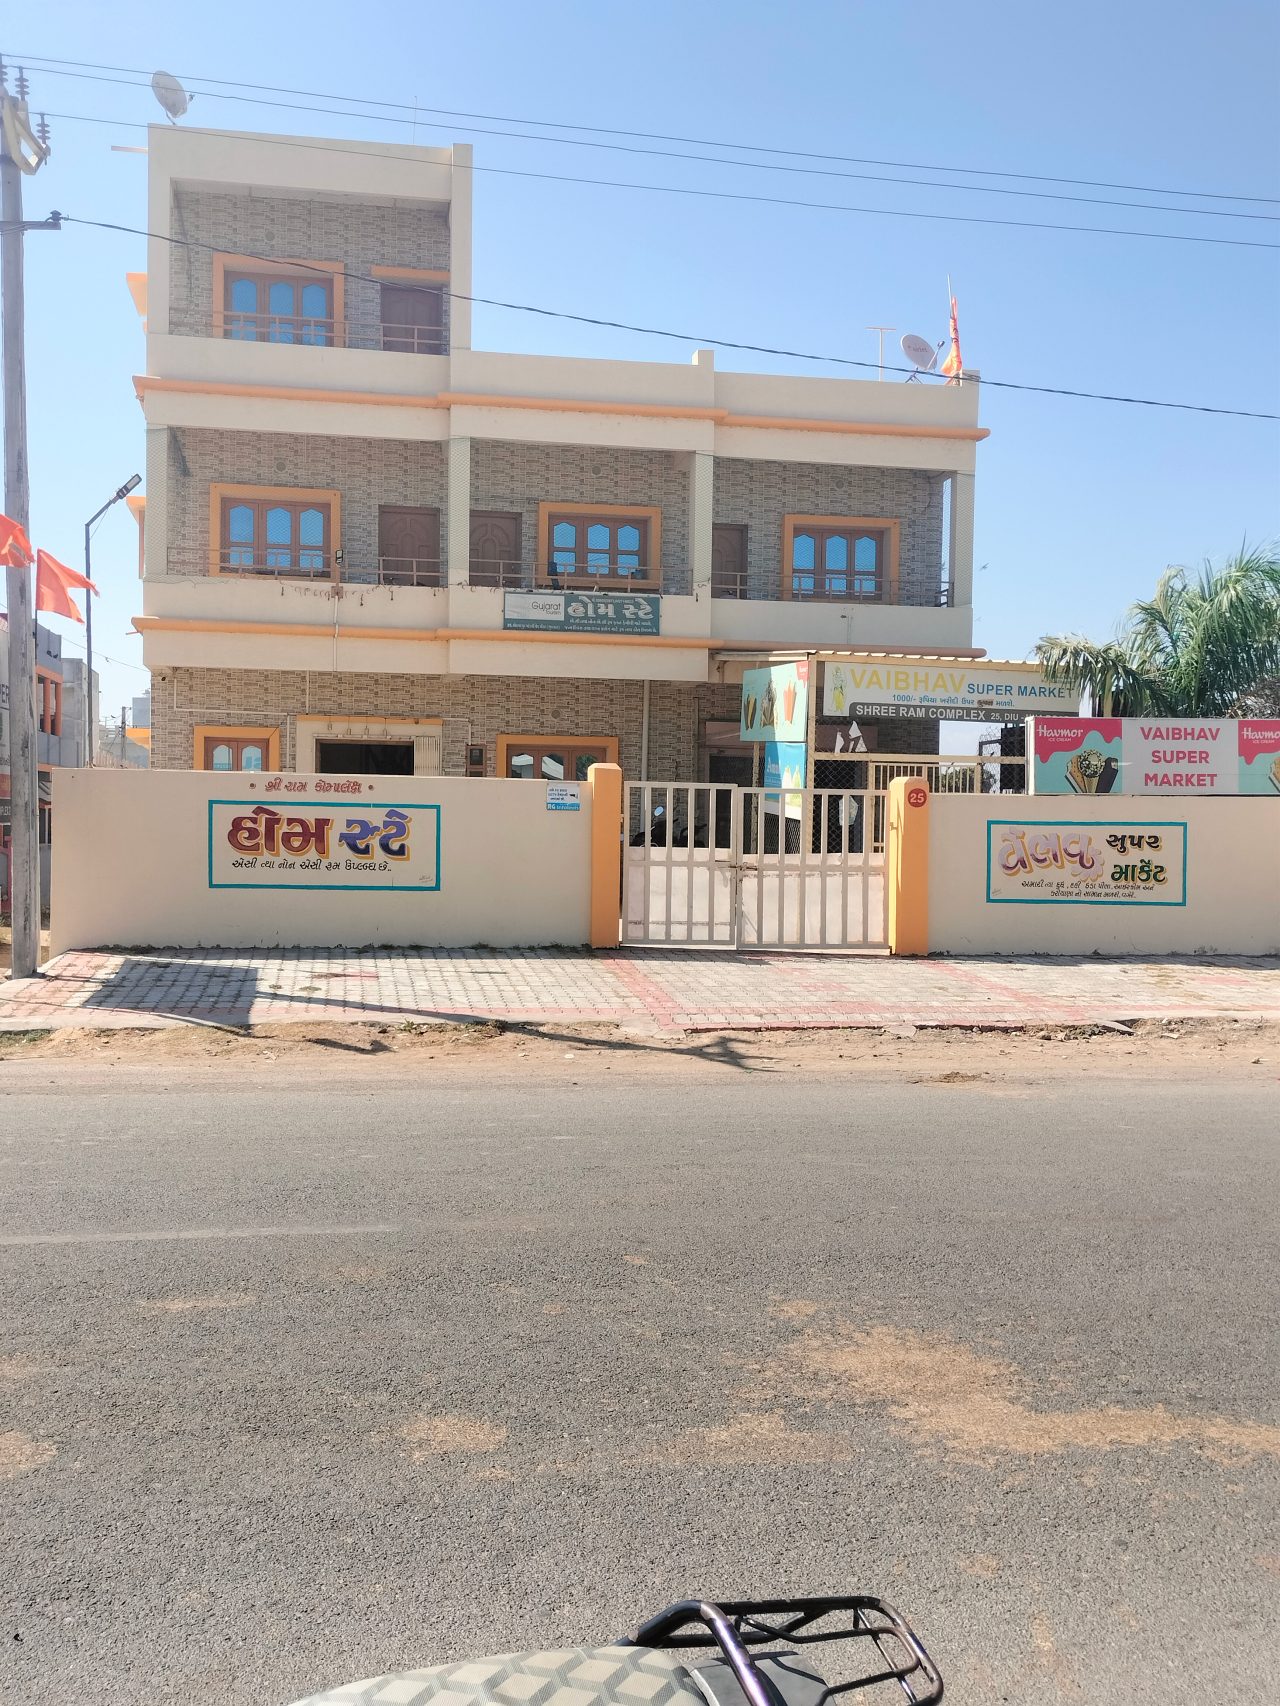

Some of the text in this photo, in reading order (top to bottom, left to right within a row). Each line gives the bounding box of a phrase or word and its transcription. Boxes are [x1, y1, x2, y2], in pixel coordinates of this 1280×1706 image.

[531, 601, 561, 612] Gujarat
[567, 596, 654, 620] હોમ સ્ટે
[850, 668, 1075, 699] VAIBHAV SUPER MARKET
[892, 694, 916, 703] 1000/-
[856, 704, 897, 718] SHREE
[899, 706, 926, 719] RAM
[928, 707, 987, 721] COMPLEX
[990, 712, 1002, 721] 25,
[1004, 713, 1019, 721] DIU
[1036, 724, 1084, 738] Havmor
[1140, 727, 1221, 741] VAIBHAV
[1151, 750, 1210, 764] SUPER
[265, 776, 283, 792] શ્રી
[284, 780, 309, 793] રામ
[1144, 773, 1218, 787] MARKET
[910, 793, 925, 803] 25
[227, 805, 413, 862] હોમ સ્ટે
[1106, 834, 1161, 855] સુપર
[232, 857, 258, 869] એસી
[299, 858, 322, 870] એસી
